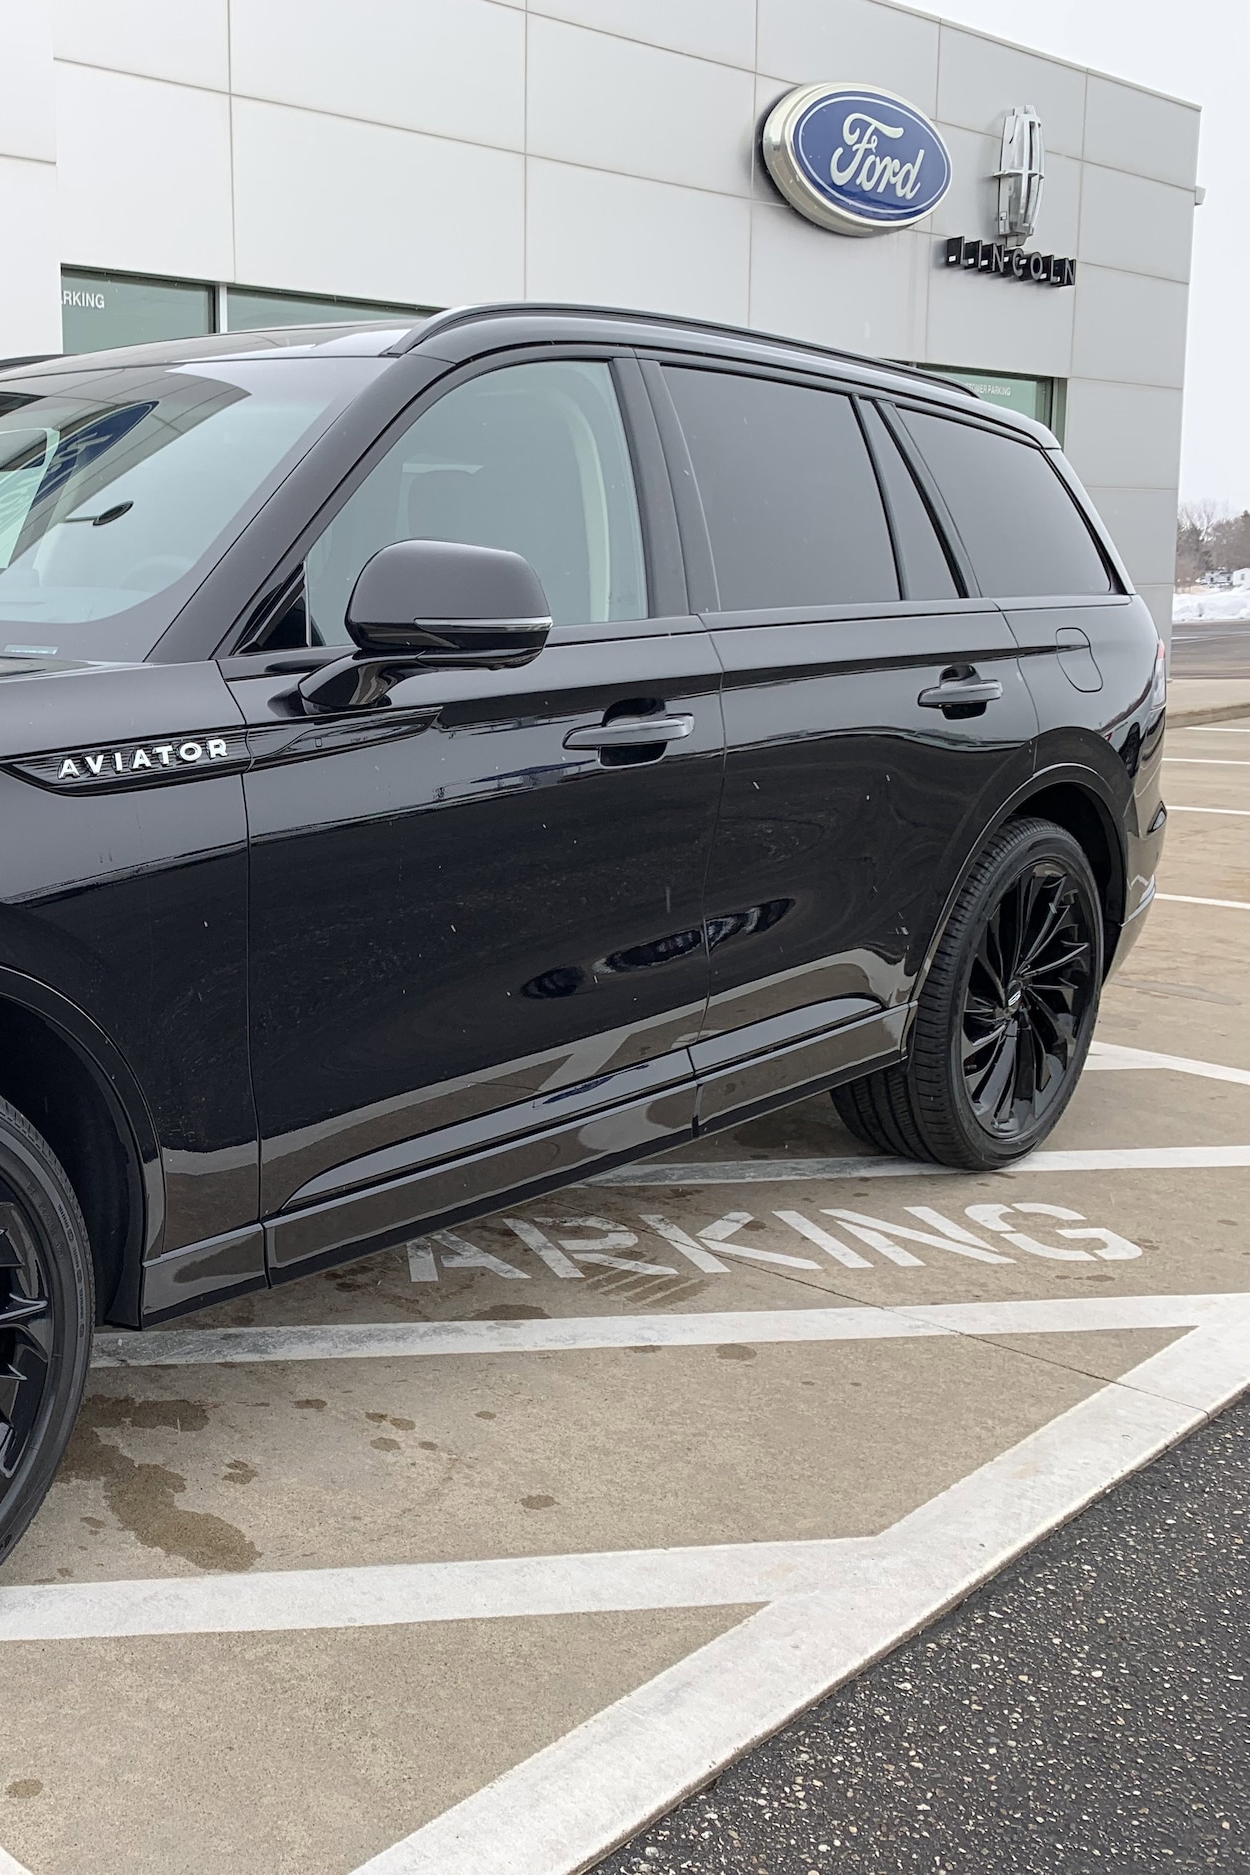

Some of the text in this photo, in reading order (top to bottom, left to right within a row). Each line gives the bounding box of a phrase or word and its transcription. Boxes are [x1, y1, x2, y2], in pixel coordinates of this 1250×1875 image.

[829, 112, 925, 200] Ford
[947, 235, 1077, 287] LINCOLN
[61, 290, 105, 309] RKING
[57, 738, 229, 779] AVIATOR
[410, 1201, 1144, 1283] ARKING
